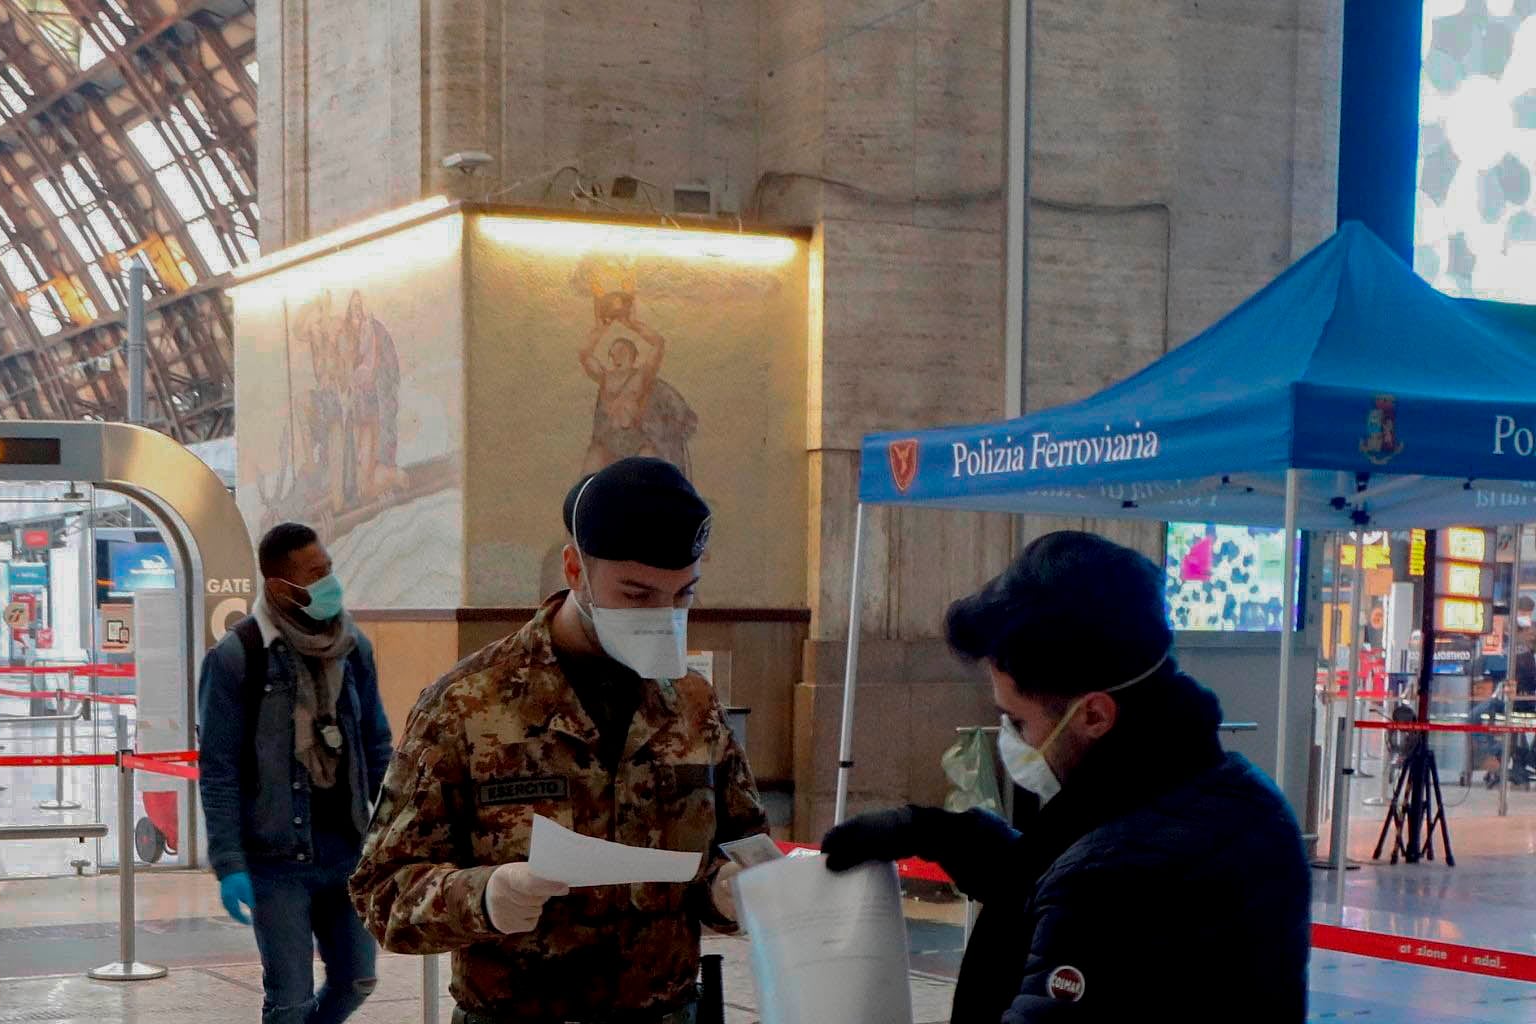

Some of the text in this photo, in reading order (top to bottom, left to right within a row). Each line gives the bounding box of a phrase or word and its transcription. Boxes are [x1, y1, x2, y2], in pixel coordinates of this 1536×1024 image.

[952, 421, 1159, 477] Polizia Ferroviaria
[207, 578, 251, 593] GATE
